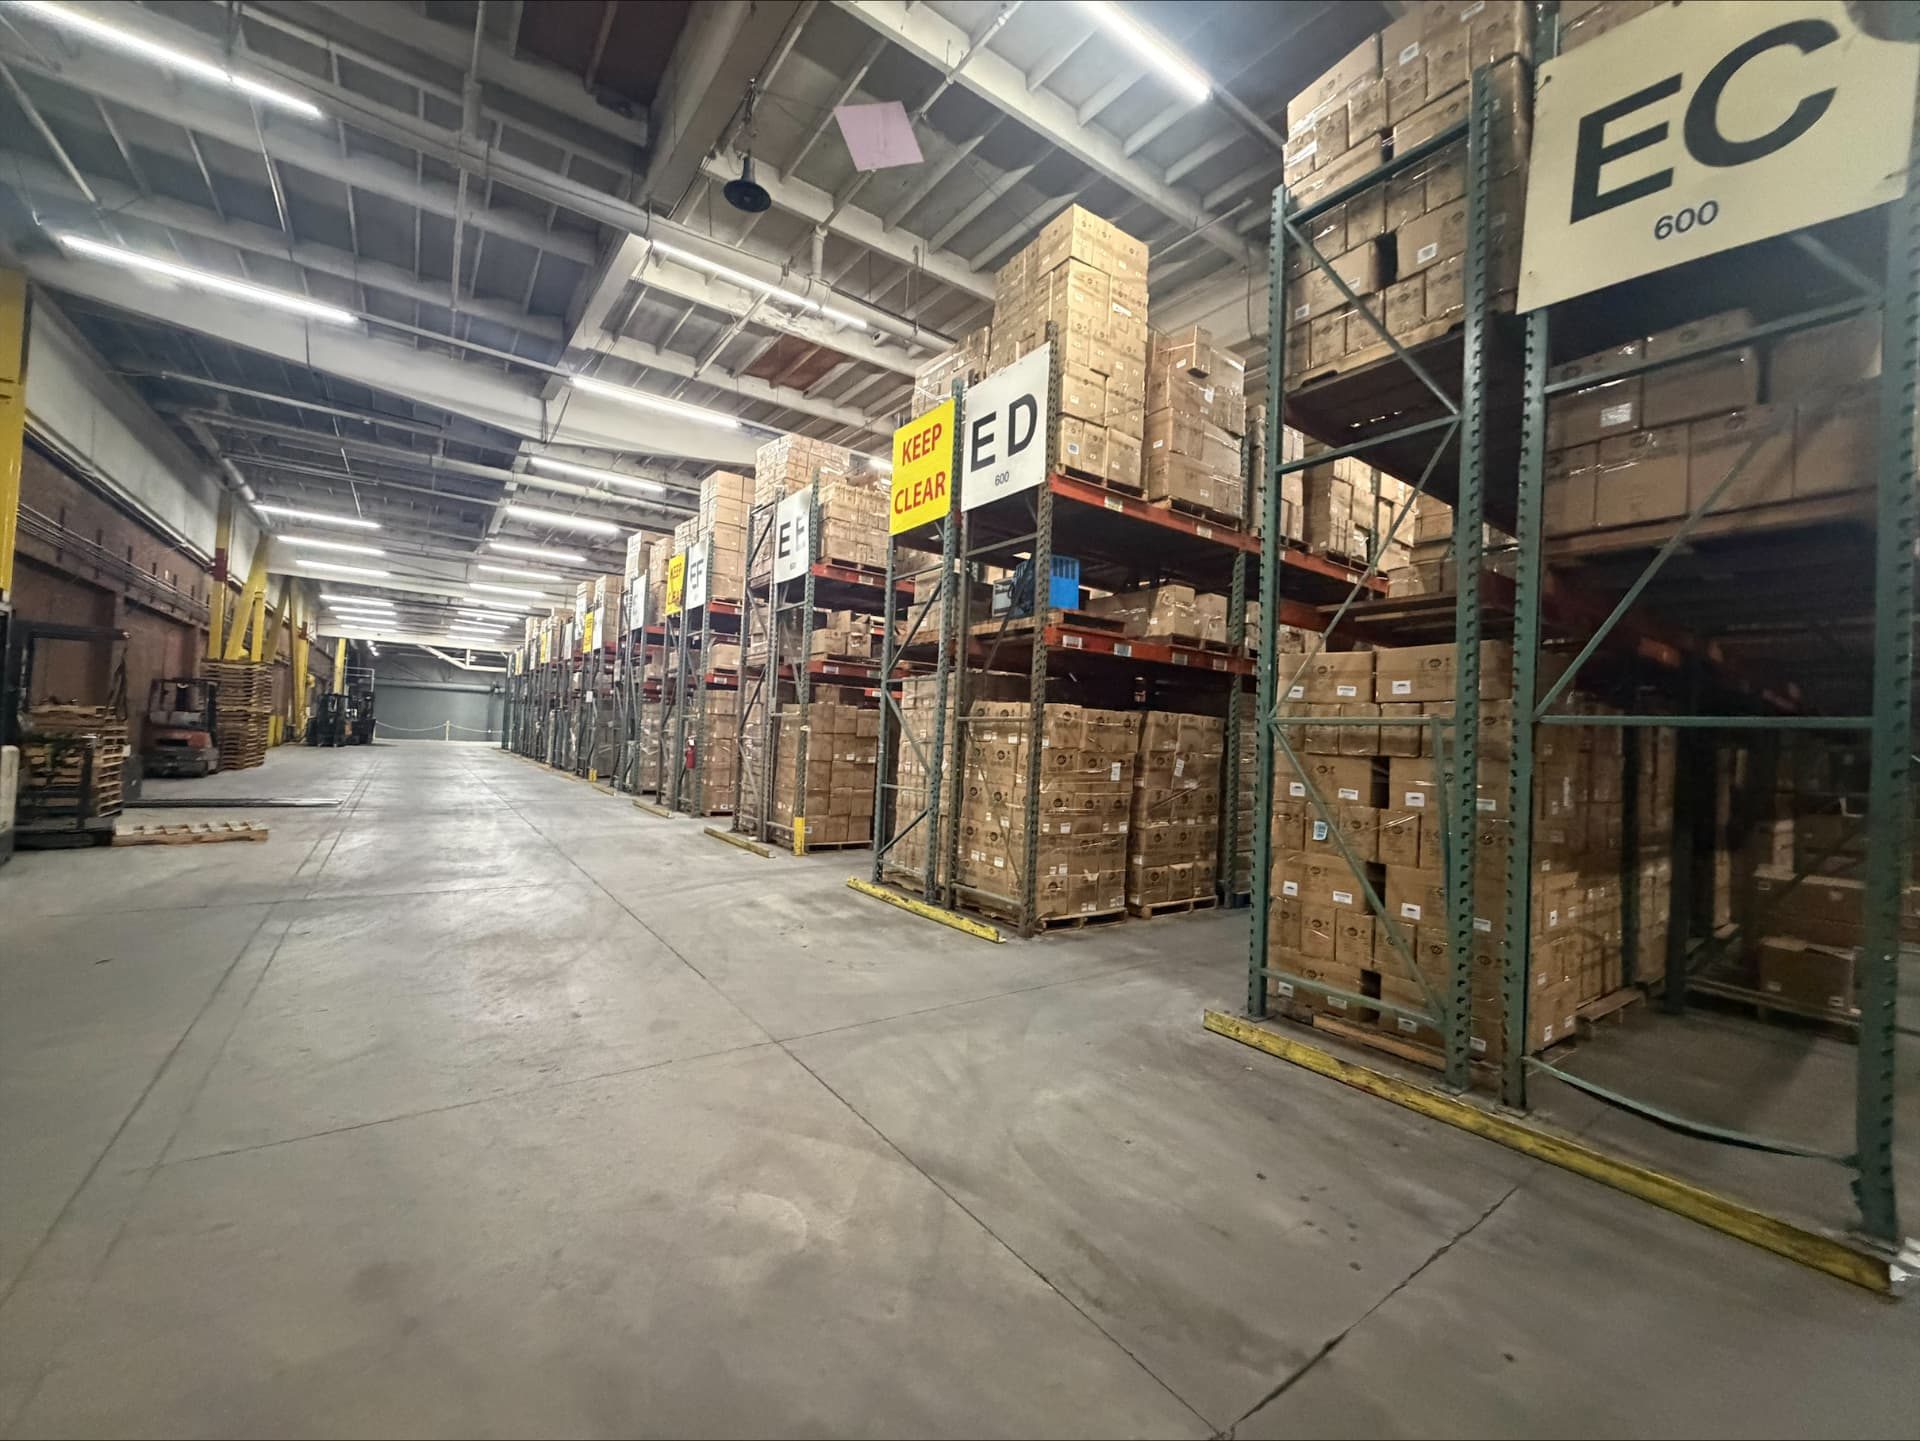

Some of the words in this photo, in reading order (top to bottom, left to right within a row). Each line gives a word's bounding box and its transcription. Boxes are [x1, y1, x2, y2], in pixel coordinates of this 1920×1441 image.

[1570, 18, 1840, 225] EC
[1654, 200, 1719, 240] 600
[902, 422, 942, 466] KEEP
[970, 393, 1038, 473] ED
[894, 471, 946, 514] CLEAR
[994, 471, 1010, 486] 600
